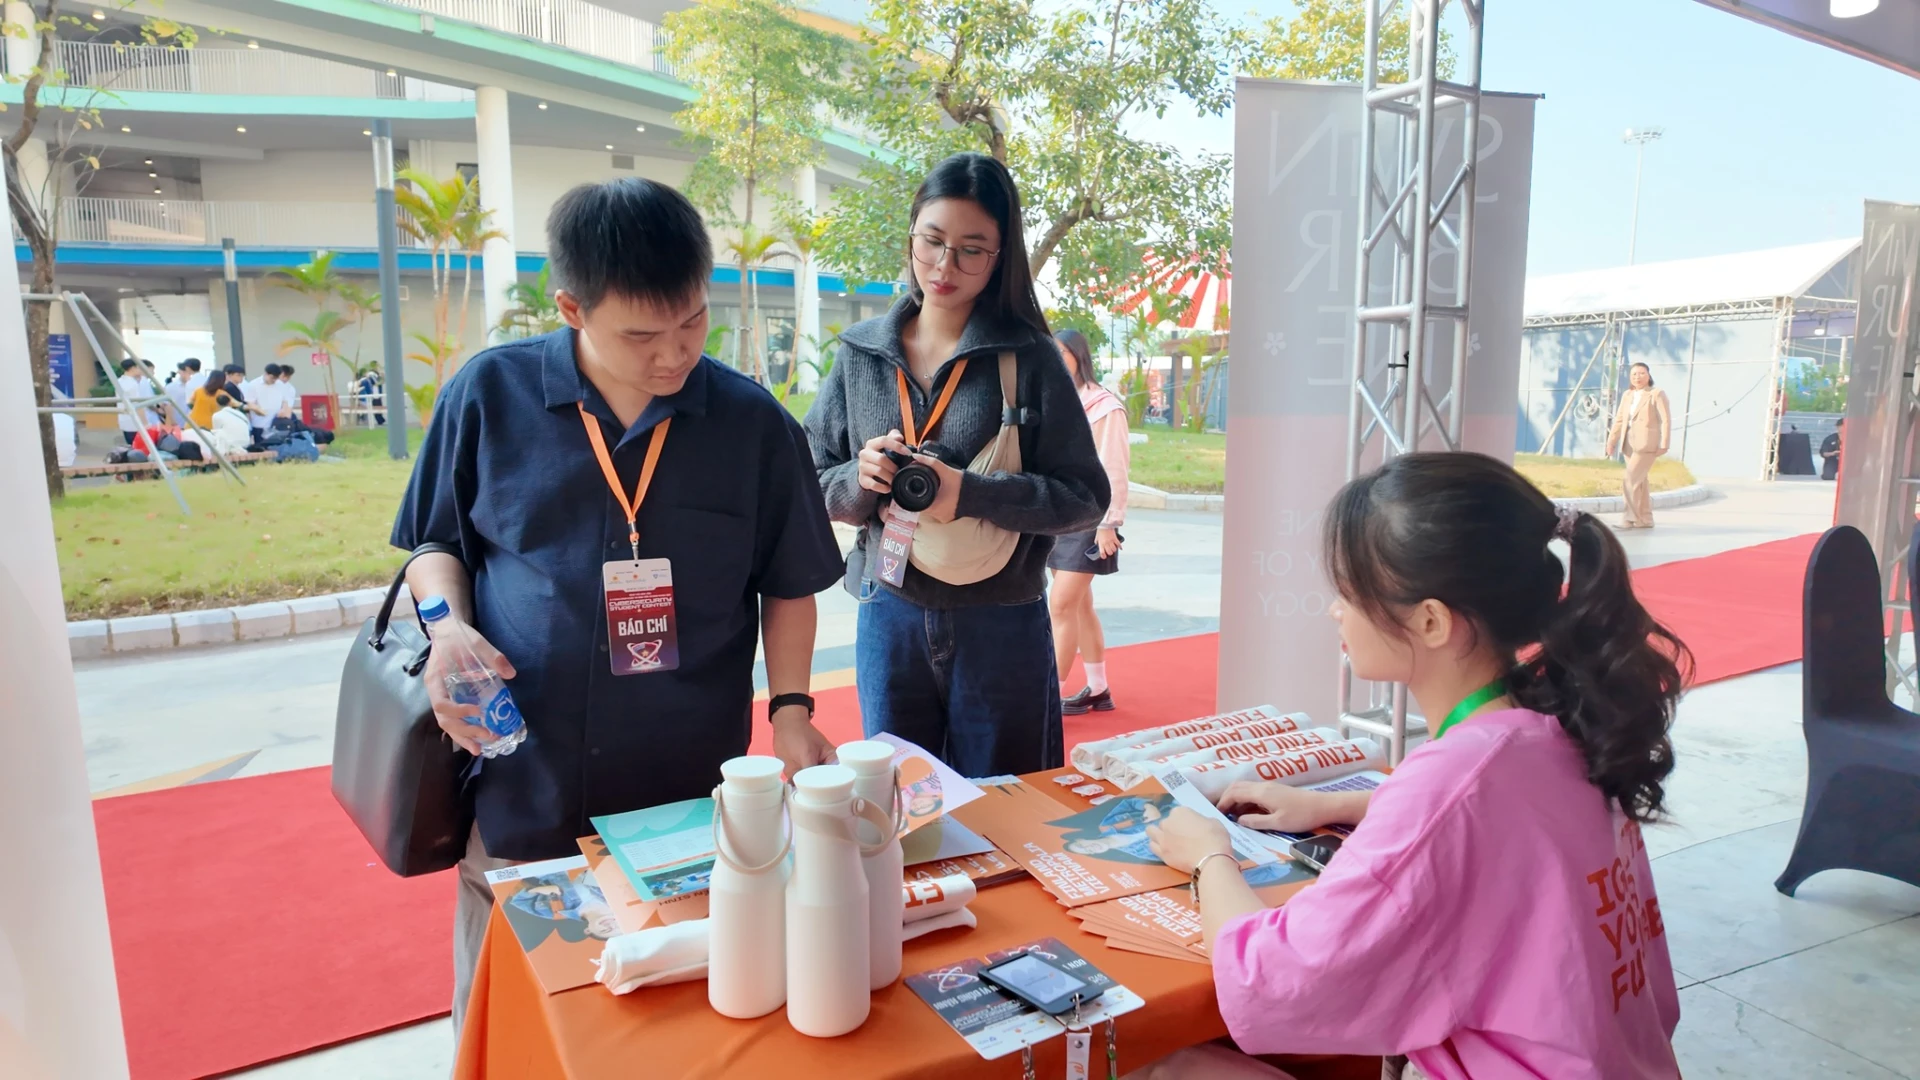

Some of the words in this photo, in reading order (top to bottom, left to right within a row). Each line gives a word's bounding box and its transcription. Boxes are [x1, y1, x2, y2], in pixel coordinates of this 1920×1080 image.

[883, 537, 895, 553] BÁO
[894, 543, 907, 557] CHÍ
[618, 618, 644, 636] BÁO
[646, 614, 668, 634] CHÍ
[1191, 715, 1298, 751] FINLAND
[1255, 743, 1367, 781] FINLAND
[1023, 842, 1097, 897] METROPOLIA
[1029, 859, 1084, 900] FINLAND
[1052, 852, 1111, 894] VIETNAM
[1118, 897, 1193, 938] FINLAND
